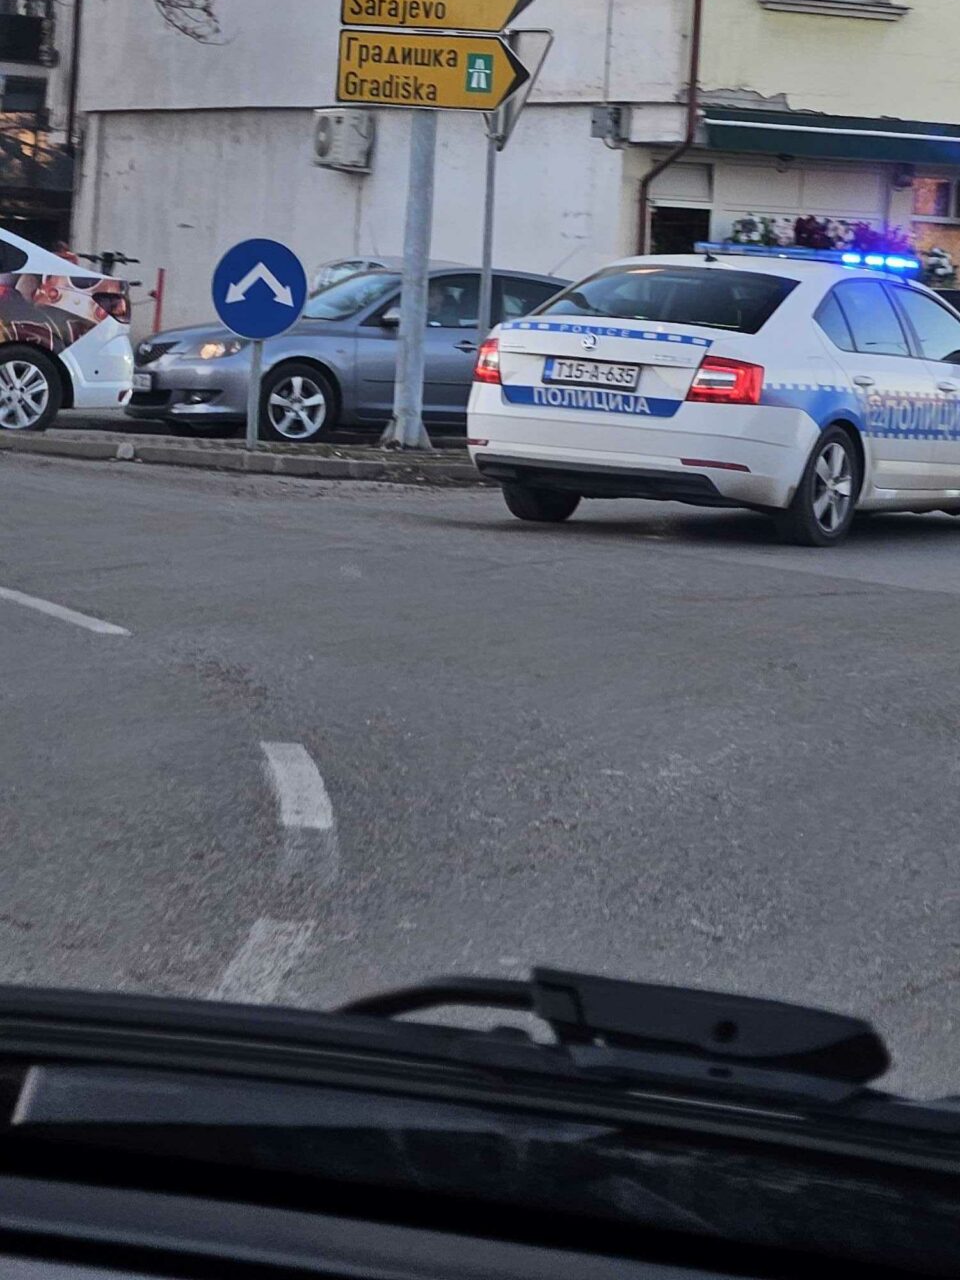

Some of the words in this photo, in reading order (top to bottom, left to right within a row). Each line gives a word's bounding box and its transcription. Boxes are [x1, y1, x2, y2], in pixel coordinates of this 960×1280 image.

[346, 37, 458, 68] Градишка
[344, 72, 438, 102] Gradiška
[559, 323, 631, 338] POLICE
[556, 361, 636, 385] T15-A-635
[533, 387, 651, 414] ПОЛИЦИЈА
